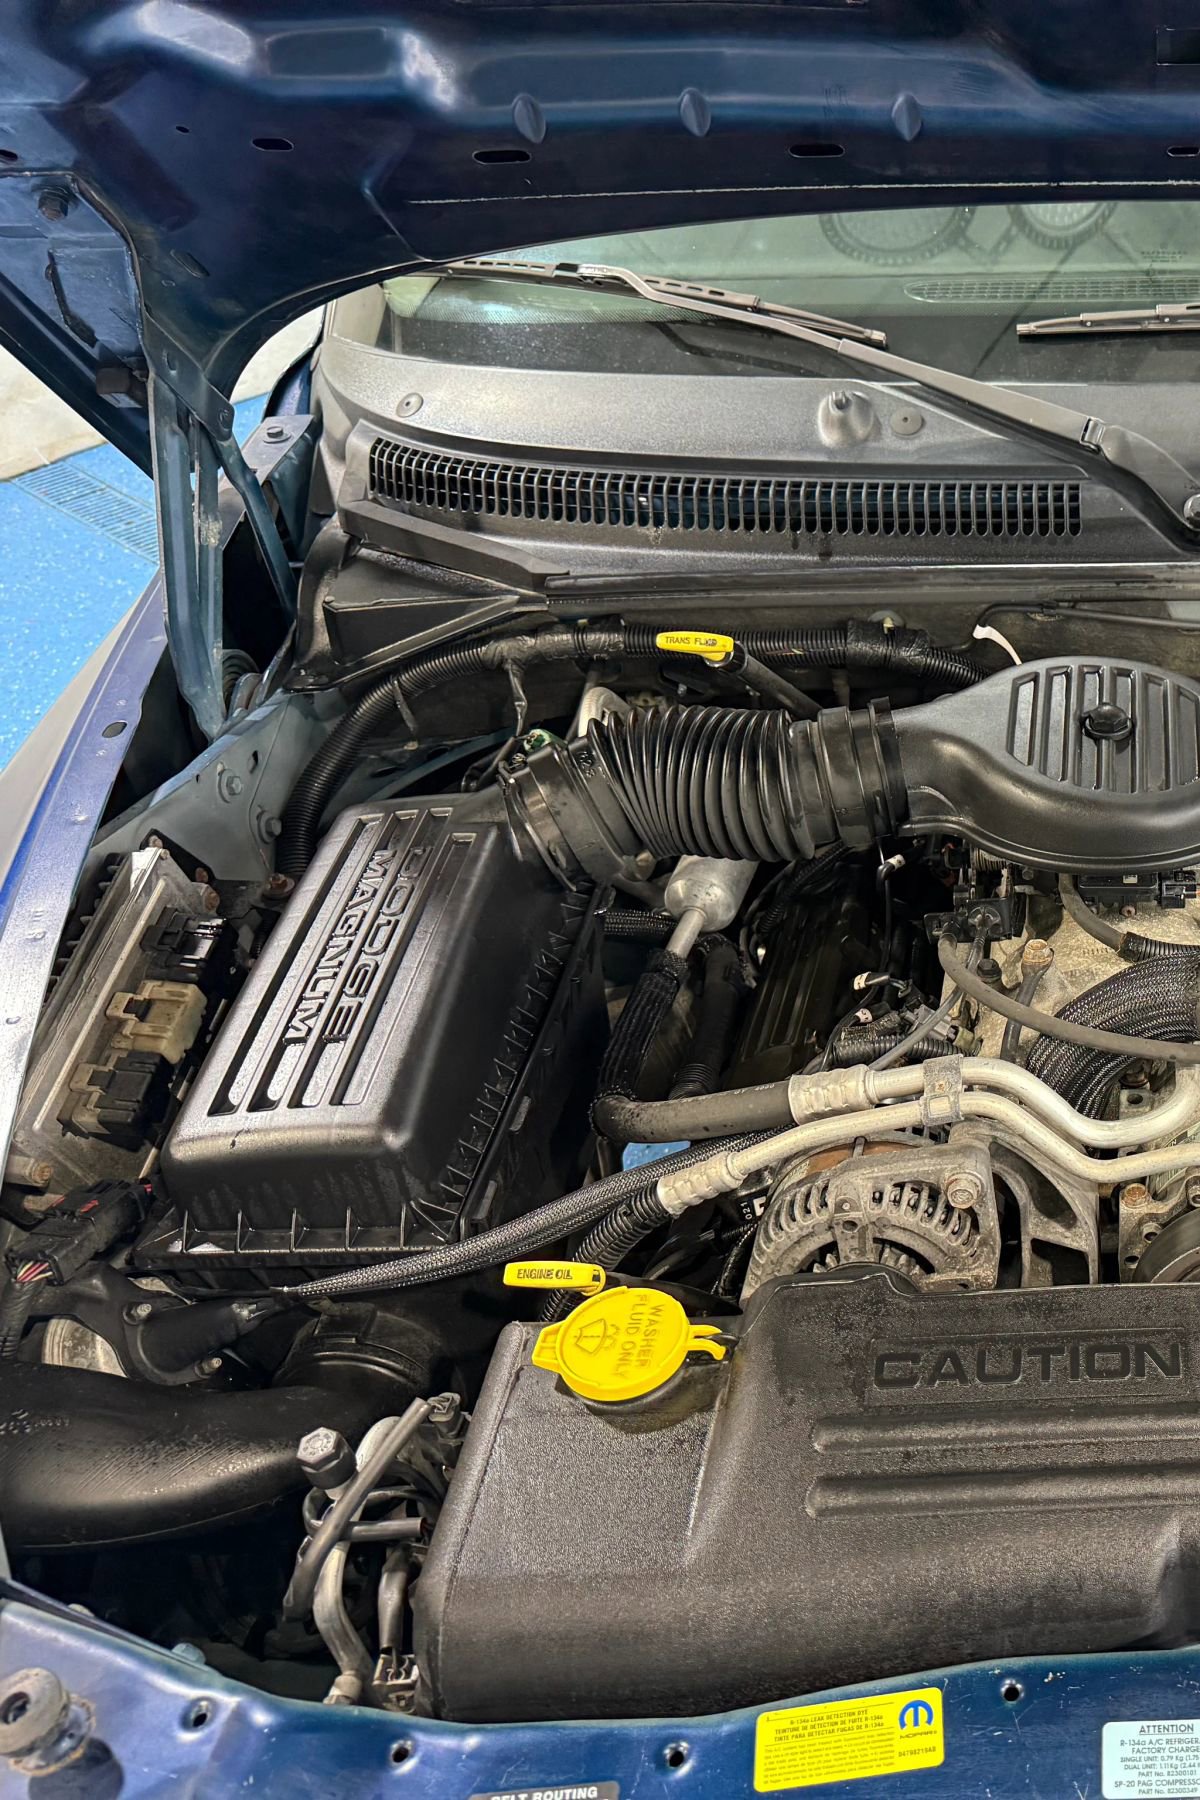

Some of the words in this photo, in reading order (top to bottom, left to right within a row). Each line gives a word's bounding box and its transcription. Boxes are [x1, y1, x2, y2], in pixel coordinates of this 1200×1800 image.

[283, 849, 392, 1046] MAGNUM
[323, 846, 432, 1042] DODGE
[516, 1268, 553, 1280] ENGINE
[555, 1269, 573, 1280] OIL
[627, 1294, 648, 1336] FLUID
[634, 1304, 666, 1370] WASHER
[611, 1341, 636, 1378] ONLY
[874, 1339, 1182, 1390] CAUTION
[775, 1726, 800, 1735] TEINTURE
[848, 1717, 865, 1725] FUITE
[865, 1714, 883, 1722] R-134a
[790, 1717, 809, 1725] R-134a
[811, 1715, 825, 1723] LEAK
[826, 1711, 856, 1720] DETECTION
[1139, 1724, 1194, 1733] ATTENTION
[792, 1732, 806, 1740] PARA
[808, 1728, 835, 1738] DETECTAR
[837, 1725, 855, 1733] FUGAS
[865, 1721, 884, 1729] R-134a
[1120, 1739, 1146, 1747] R-134a
[532, 1786, 598, 1800] ROUTING
